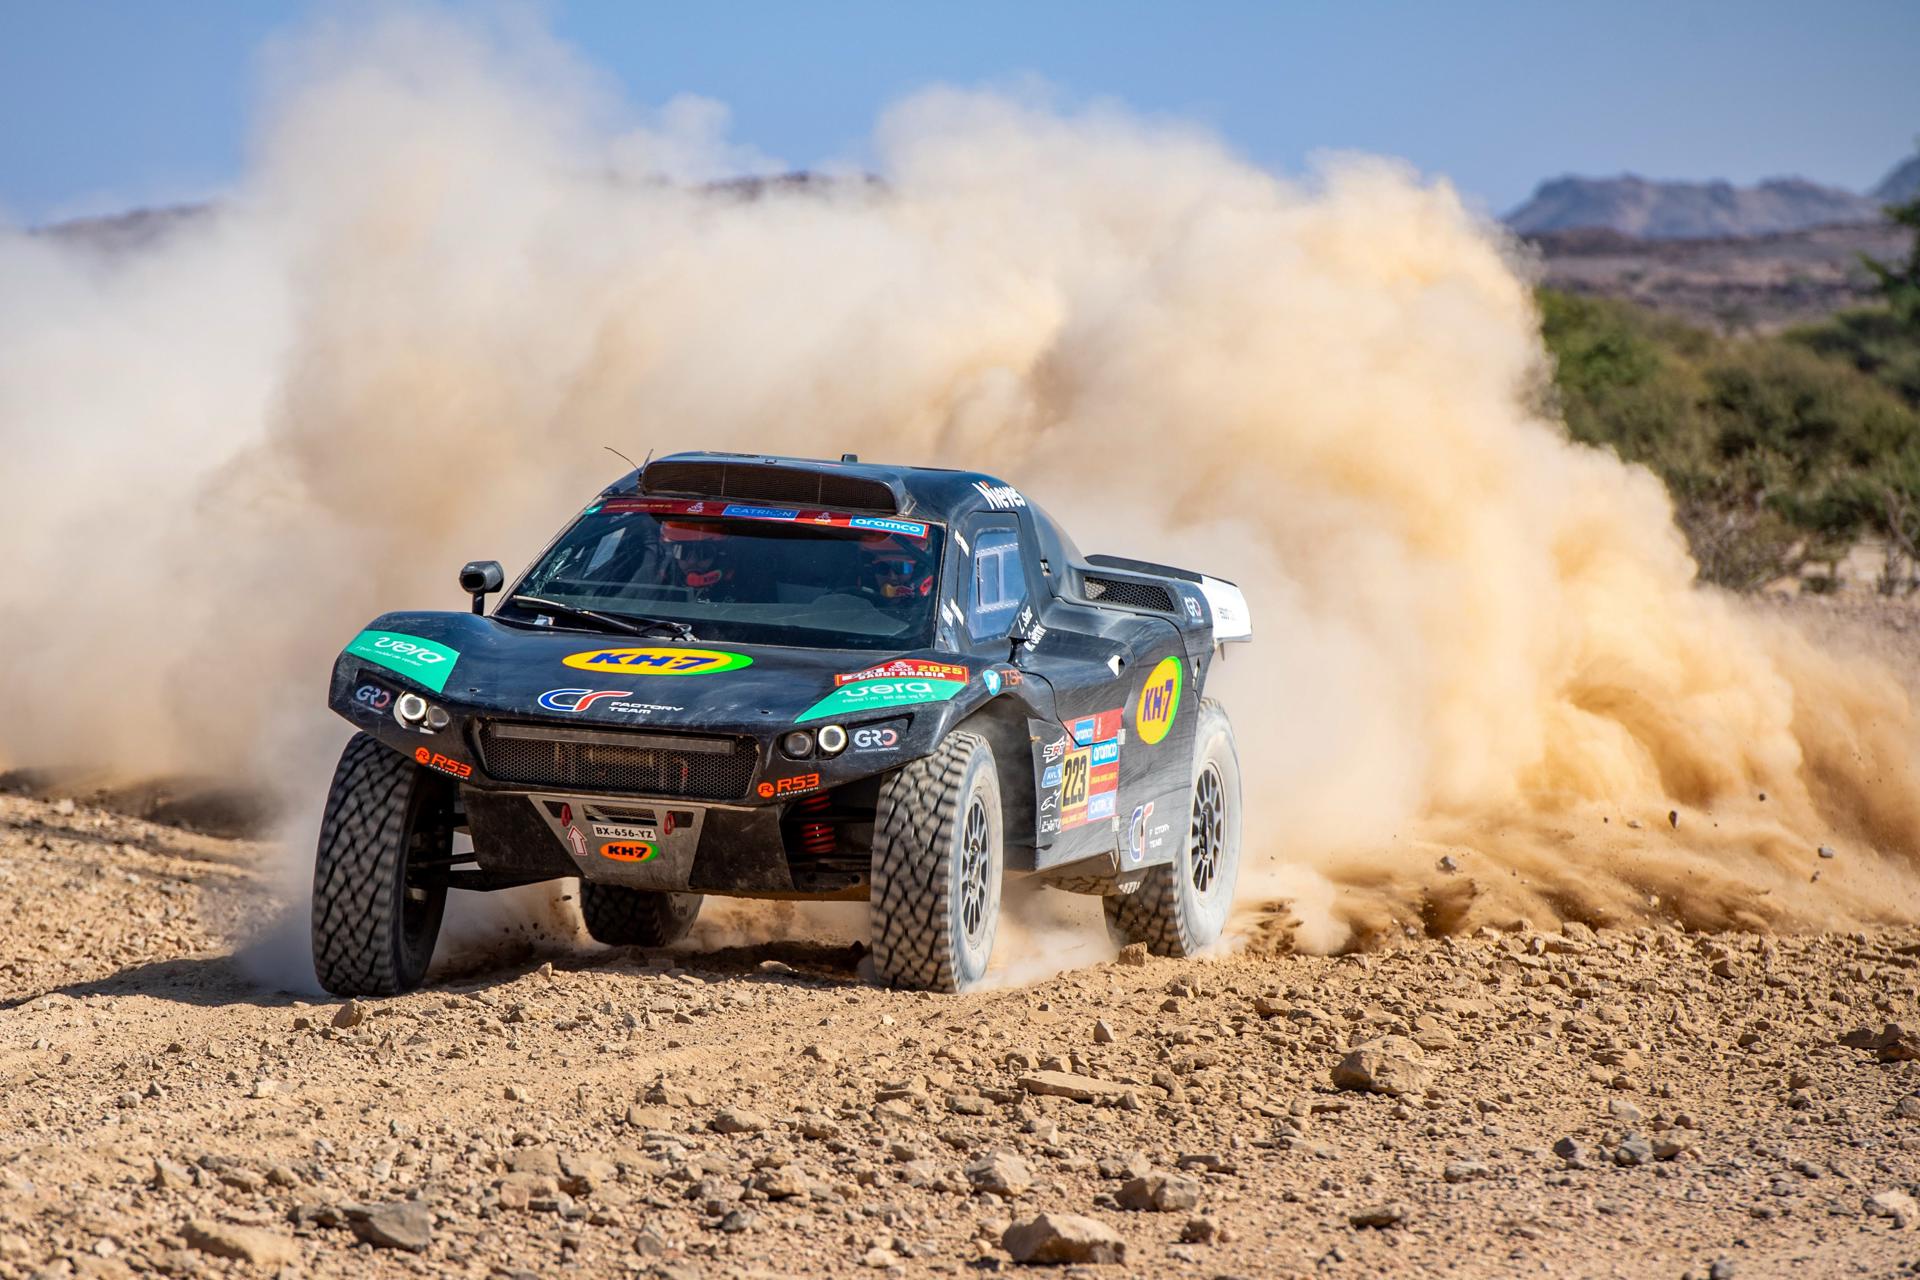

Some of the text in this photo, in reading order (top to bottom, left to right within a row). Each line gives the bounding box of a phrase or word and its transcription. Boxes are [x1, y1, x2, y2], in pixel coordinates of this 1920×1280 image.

[972, 481, 1026, 510] Nieves
[855, 518, 921, 533] aramco
[374, 637, 447, 663] vera
[918, 665, 963, 675] 2025
[837, 682, 933, 697] vera
[611, 701, 684, 711] FACTORY
[1093, 743, 1118, 761] aramco
[431, 753, 472, 776] R53
[777, 773, 819, 792] R53
[1063, 755, 1087, 807] 223
[596, 827, 653, 839] BX-656-YZ
